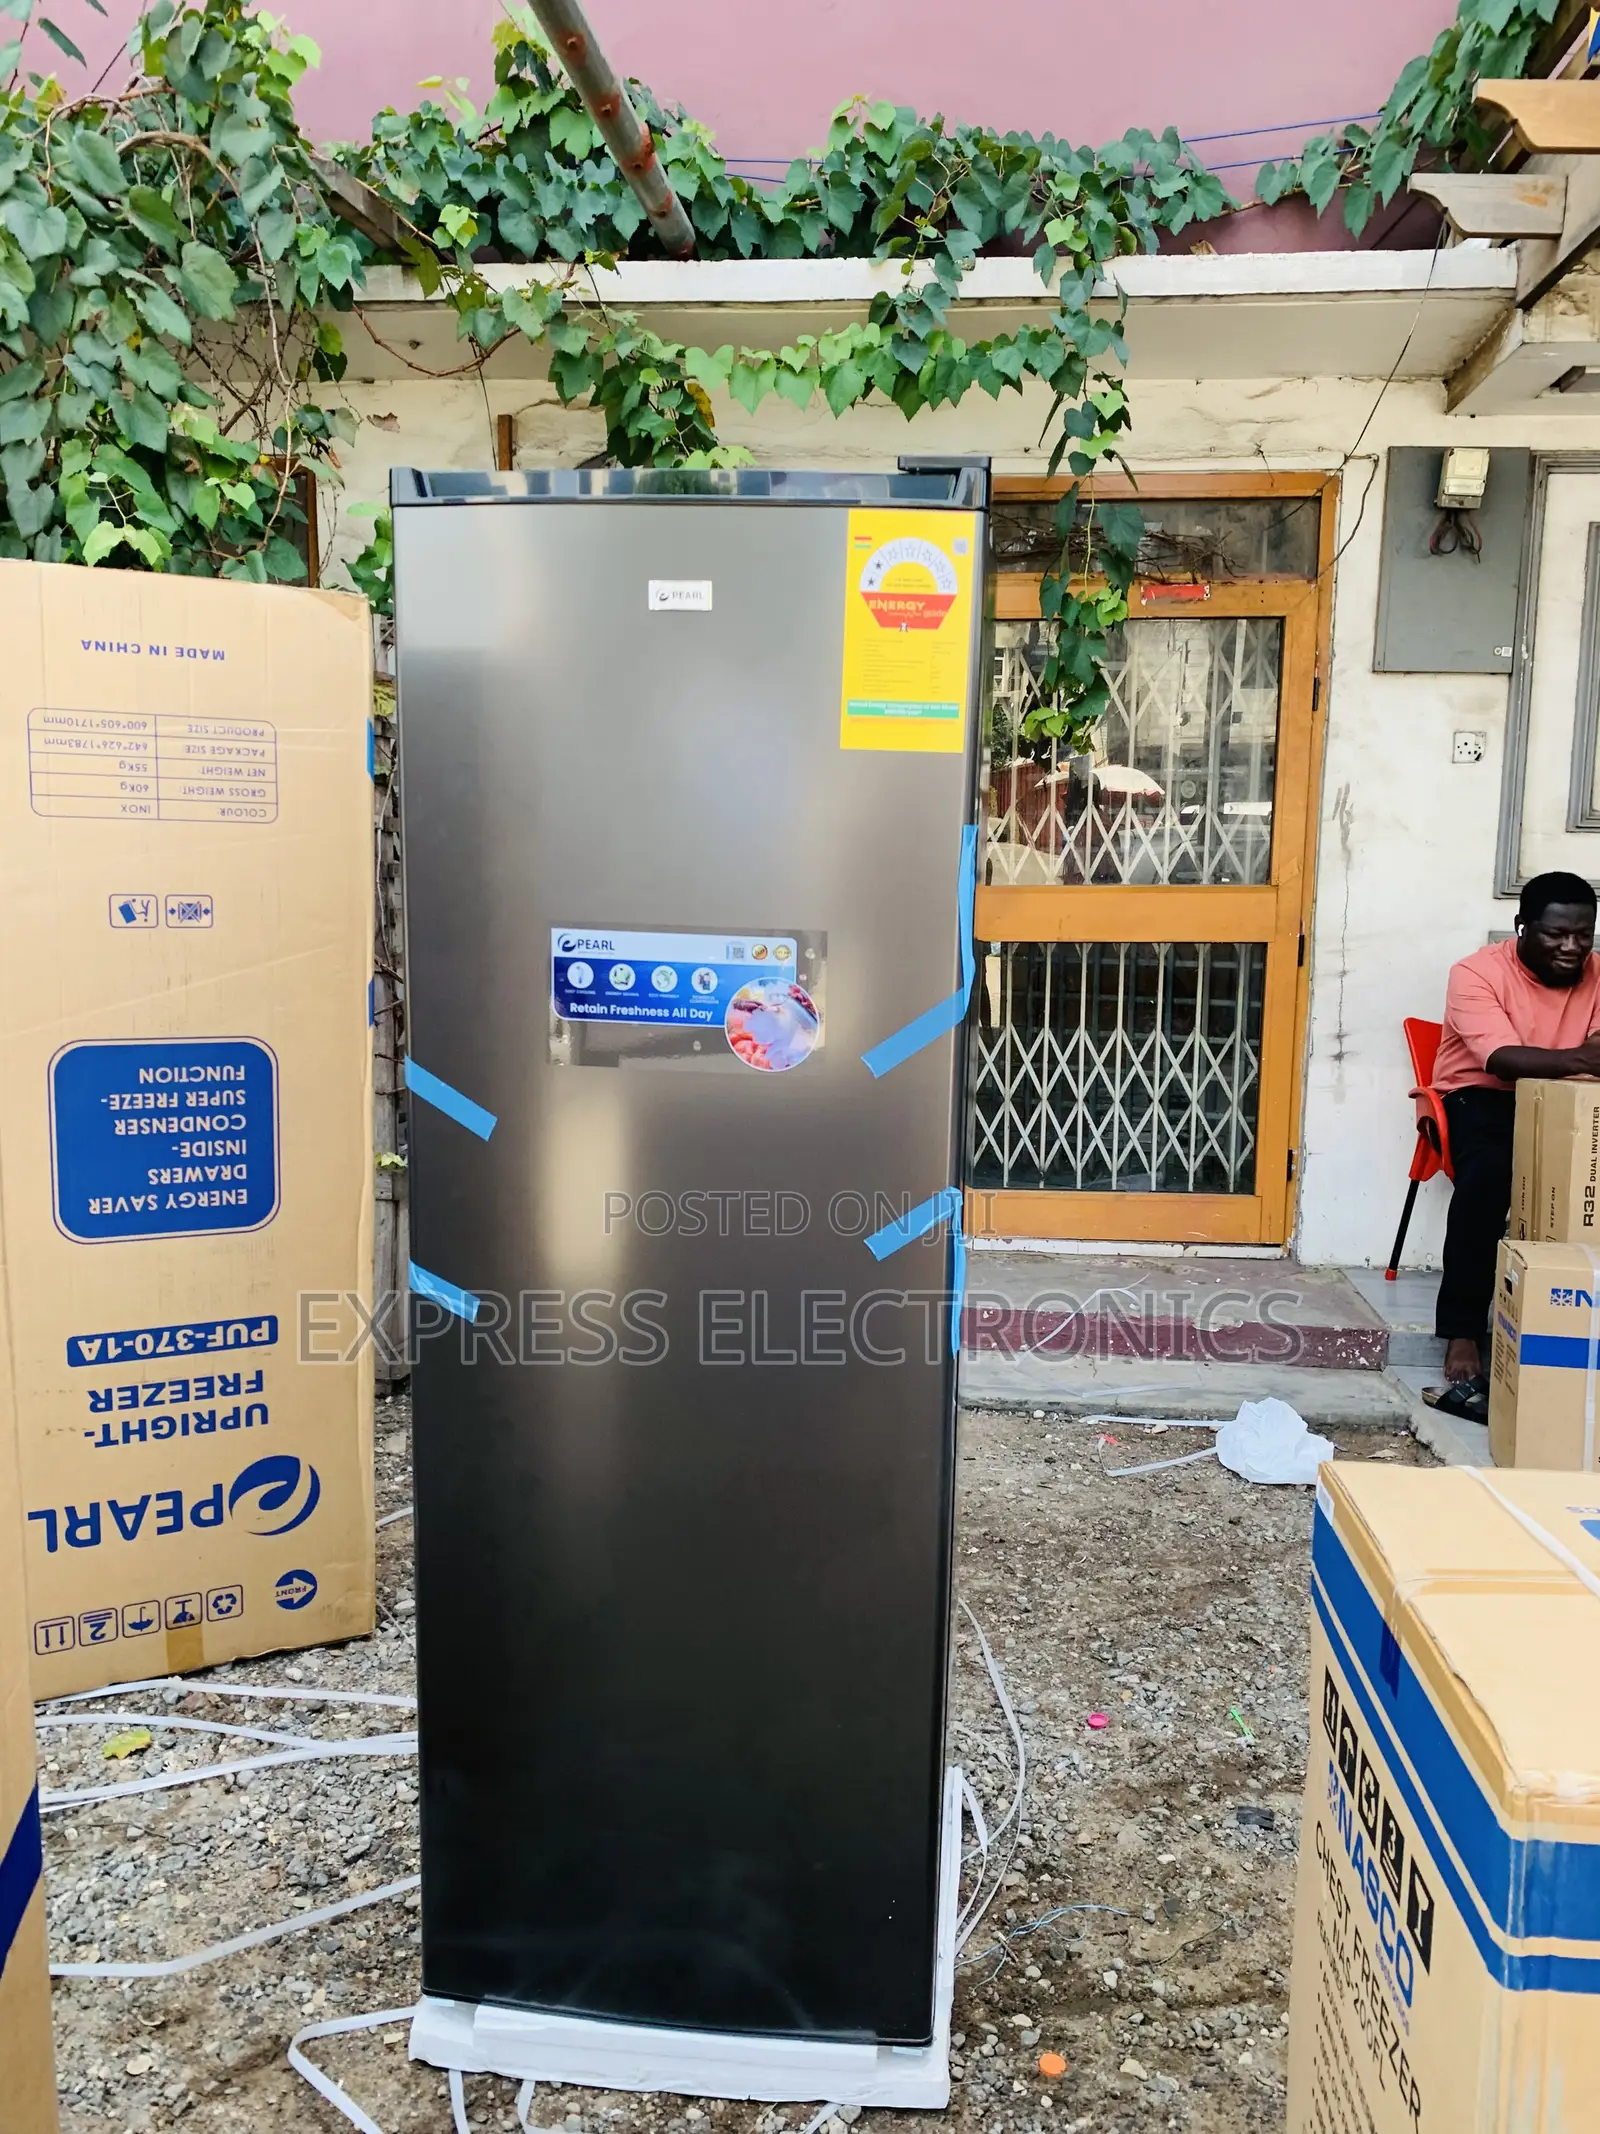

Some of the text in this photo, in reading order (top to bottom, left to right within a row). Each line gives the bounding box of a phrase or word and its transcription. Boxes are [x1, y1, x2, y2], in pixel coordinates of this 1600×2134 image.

[868, 598, 926, 612] ENERGY
[81, 639, 225, 661] MADE IN CHINA
[212, 725, 265, 737] PRODUCT
[210, 746, 265, 757] PACKAGE
[247, 768, 266, 777] NET
[228, 787, 266, 798] GROSS
[121, 804, 151, 814] INOX
[577, 939, 615, 951] PEARL
[569, 1002, 713, 1021] Retain Freshness All Day
[139, 1065, 246, 1084] FUNCTION
[100, 1089, 246, 1111] SUPER FREEZE-
[114, 1114, 247, 1136] CONDENSER
[171, 1139, 247, 1158] INSIDE-
[148, 1164, 247, 1185] DRAWERS
[1583, 1106, 1600, 1227] R32 DUAL INVERTER
[88, 1189, 248, 1215] ENERGY SAVER
[77, 1319, 270, 1362] PUF-370-1A
[87, 1369, 264, 1414] FREEZER
[84, 1402, 270, 1448] UPRIGHT-
[27, 1482, 225, 1553] PEARL
[275, 1583, 308, 1598] FRONT
[1338, 1785, 1414, 2009] NASCO
[1316, 1820, 1421, 2134] CHEST FREEZER
[1332, 1918, 1386, 2093] NAS-200FL
